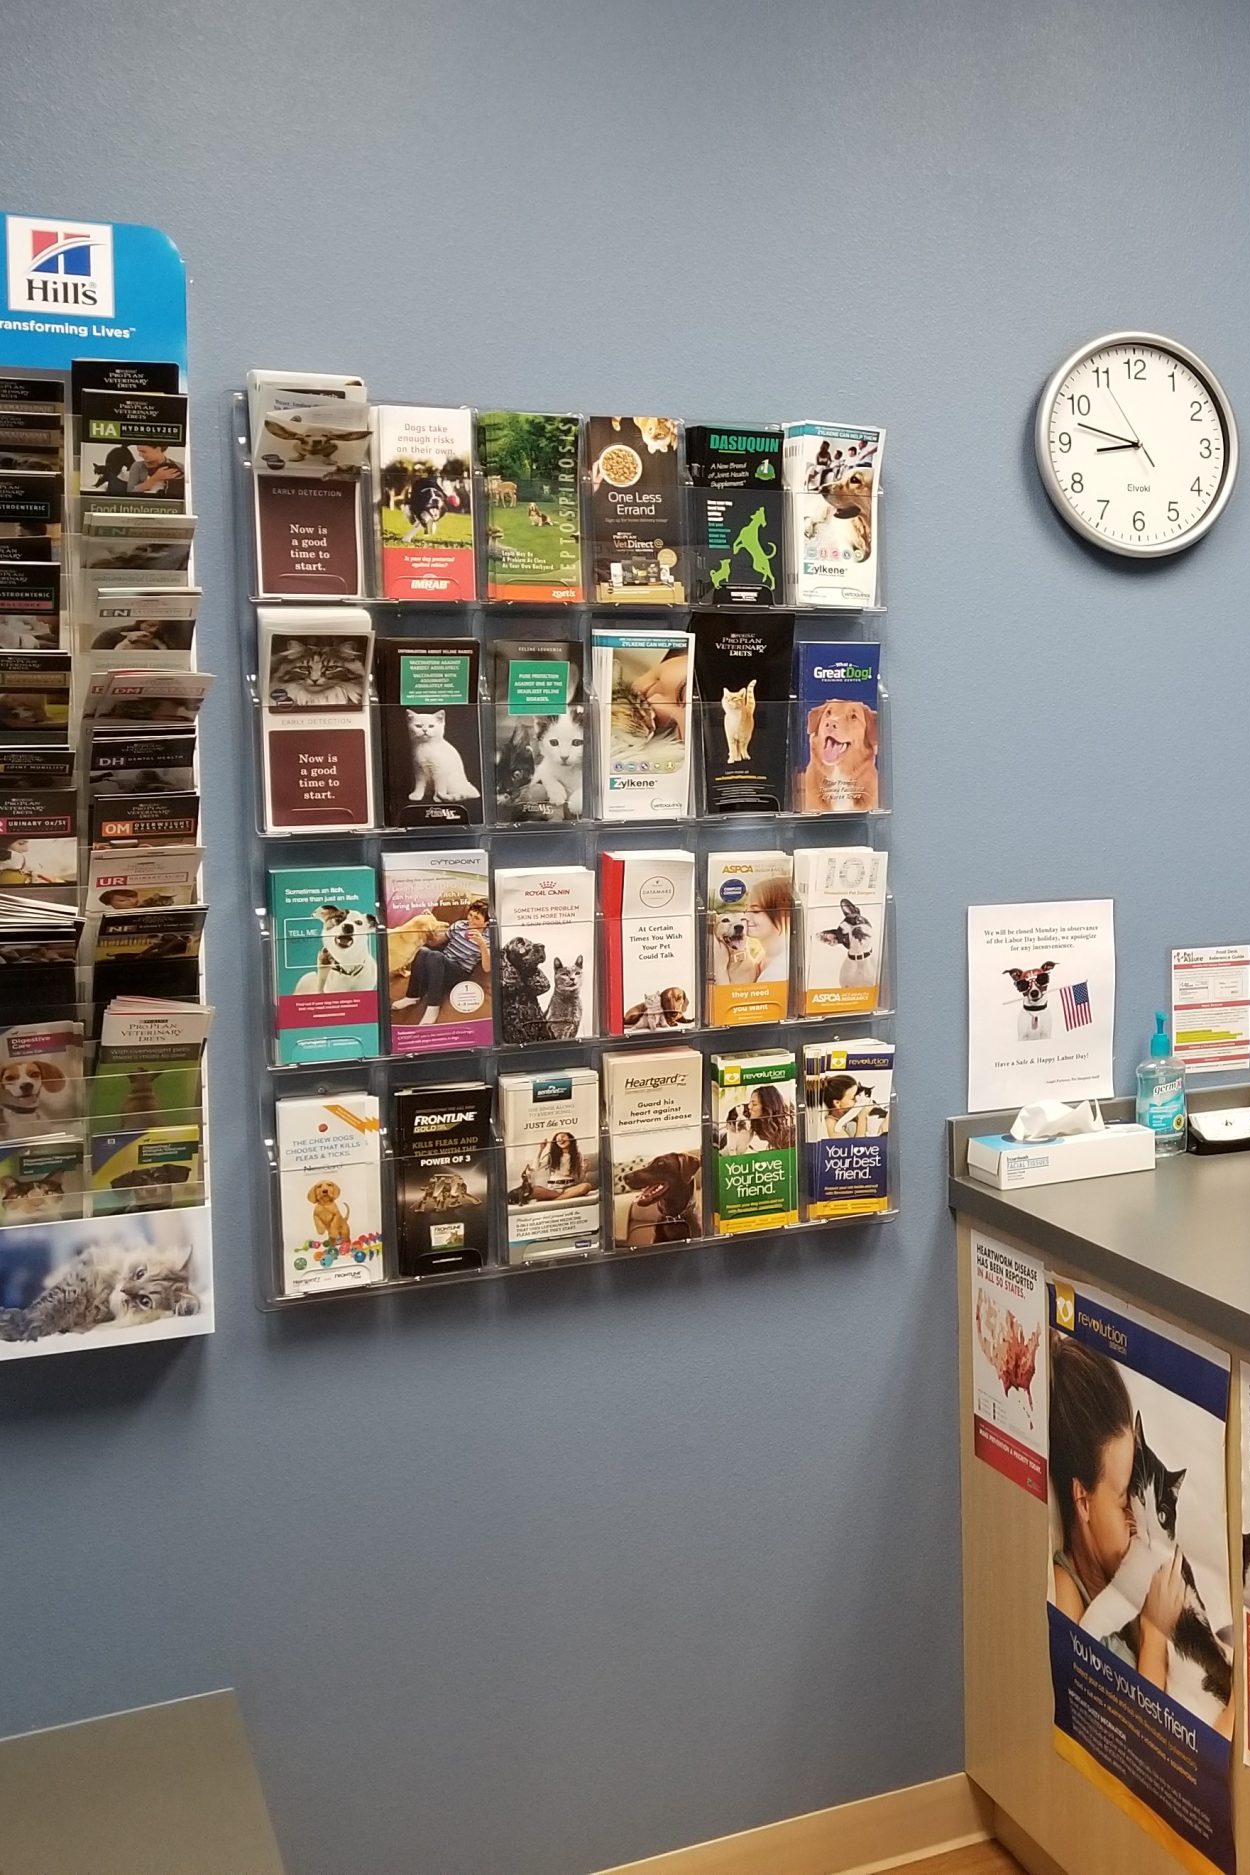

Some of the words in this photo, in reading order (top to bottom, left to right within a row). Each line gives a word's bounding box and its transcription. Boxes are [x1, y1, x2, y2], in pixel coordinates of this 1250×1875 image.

[0, 320, 88, 338] ransforming
[1123, 358, 1147, 380] 12
[1092, 366, 1110, 388] 11
[1168, 371, 1176, 392] 1
[1067, 394, 1090, 416] 10
[1190, 401, 1202, 422] 2
[92, 423, 118, 436] HA
[121, 424, 179, 434] HYDROLYZED
[404, 424, 426, 433] Dogs
[429, 424, 448, 433] take
[398, 435, 430, 445] enough
[433, 435, 455, 444] risks
[710, 434, 780, 453] DASUQUIN
[1058, 432, 1072, 453] 9
[410, 446, 432, 454] their
[1200, 438, 1212, 459] 3
[1070, 472, 1084, 494] 8
[1190, 476, 1203, 497] 4
[272, 488, 296, 496] EARLY
[298, 489, 342, 497] DETECTION
[608, 492, 633, 504] One
[636, 492, 662, 504] Less
[559, 422, 577, 583] LEPTOSPIROSIS
[616, 504, 656, 516] Errand
[1097, 500, 1110, 520] 7
[1167, 501, 1180, 522] 5
[1132, 511, 1146, 532] 6
[290, 524, 314, 534] Now
[318, 526, 328, 534] is
[292, 538, 298, 546] a
[302, 537, 327, 549] good
[290, 550, 315, 559] time
[318, 550, 330, 559] to
[295, 562, 326, 572] start.
[298, 754, 324, 763] Now
[328, 754, 338, 763] is
[311, 766, 336, 779] good
[299, 778, 324, 788] time
[328, 779, 340, 787] to
[304, 790, 336, 800] start.
[722, 864, 754, 874] ASPCA
[524, 889, 546, 897] ROYAL
[732, 990, 749, 998] they
[750, 989, 770, 997] need
[732, 1005, 748, 1014] you
[750, 1004, 768, 1012] want
[848, 1056, 889, 1066] revolution
[624, 1074, 678, 1089] Heartgard
[743, 1070, 786, 1080] revolution
[638, 1100, 662, 1108] Guard
[630, 1108, 650, 1116] heart
[652, 1106, 681, 1116] against
[414, 1111, 478, 1126] FRONTLINE
[524, 1122, 545, 1130] JUST
[560, 1118, 578, 1126] YOU
[618, 1117, 662, 1126] heartworm
[664, 1114, 692, 1122] disease
[414, 1125, 437, 1134] GOLD
[308, 1137, 331, 1146] CHEW
[332, 1134, 354, 1143] DOGS
[286, 1147, 317, 1155] CHOOSE
[319, 1144, 338, 1152] THAT
[340, 1142, 360, 1150] KILLS
[826, 1145, 848, 1158] You
[850, 1144, 880, 1156] love
[296, 1154, 318, 1162] FLEAS
[420, 1156, 450, 1167] POWER
[452, 1156, 464, 1164] OF
[824, 1158, 851, 1172] your
[852, 1154, 882, 1168] best
[725, 1162, 748, 1175] You
[752, 1159, 782, 1172] love
[725, 1174, 755, 1190] your
[756, 1169, 786, 1183] best
[834, 1168, 872, 1180] friend.
[736, 1182, 776, 1198] friend.
[977, 1243, 1014, 1270] HEARTWORM
[1014, 1260, 1038, 1282] DISEASE
[977, 1255, 988, 1270] HAS
[989, 1260, 1004, 1276] BEEN
[1004, 1266, 1034, 1292] REPORTED
[976, 1268, 984, 1278] IN
[984, 1272, 995, 1284] ALL
[996, 1276, 1004, 1289] 50
[1004, 1280, 1026, 1300] STATES.
[1078, 1312, 1128, 1348] revolution
[1070, 1630, 1088, 1660] You
[1089, 1648, 1114, 1682] love
[1114, 1668, 1138, 1701] your
[1138, 1686, 1162, 1722] best
[1164, 1708, 1199, 1753] friend.
